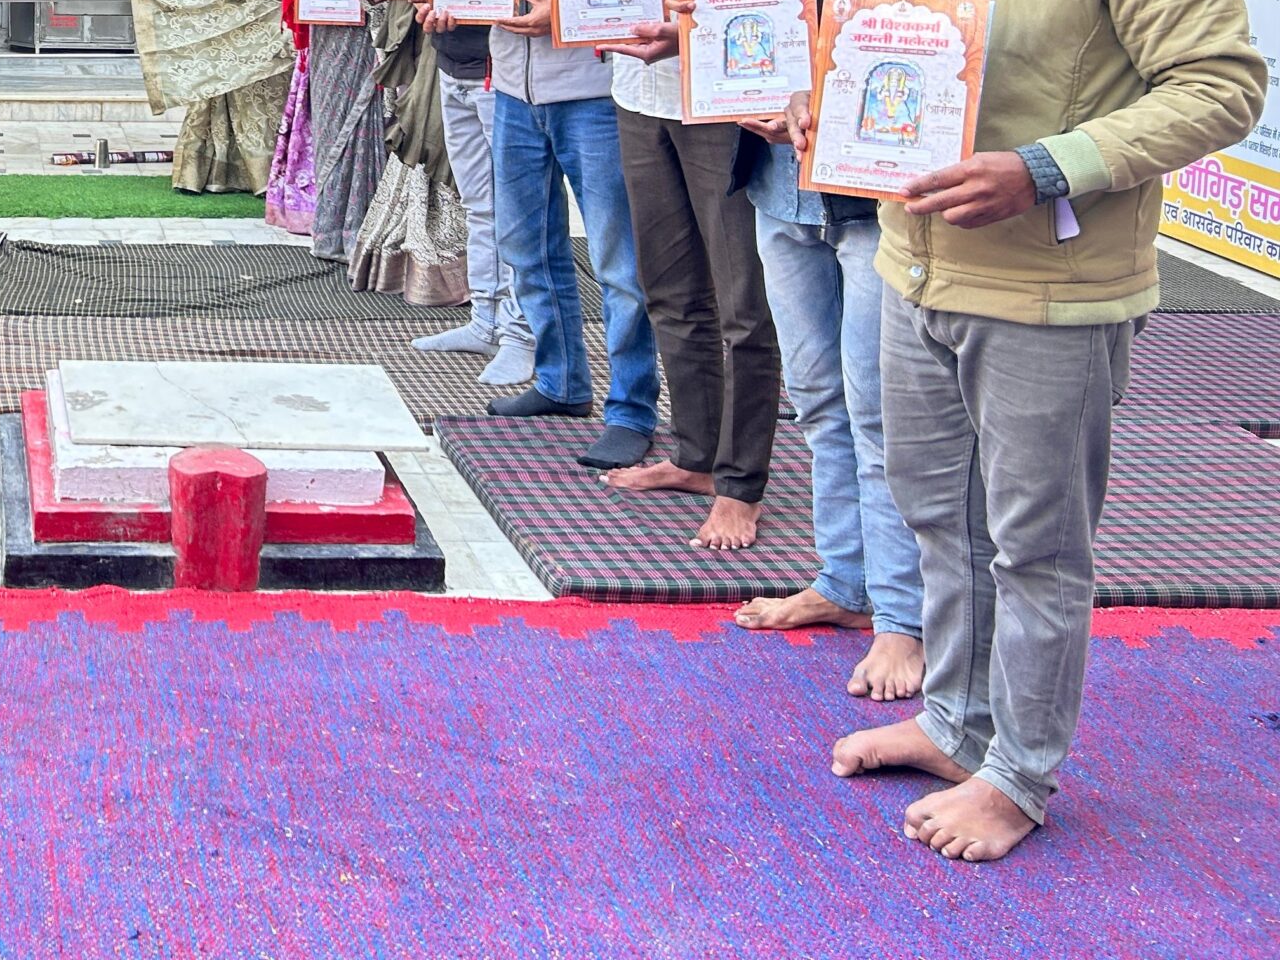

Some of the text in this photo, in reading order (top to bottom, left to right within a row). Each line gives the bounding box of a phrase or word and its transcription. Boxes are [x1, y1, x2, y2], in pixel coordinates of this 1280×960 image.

[860, 18, 941, 34] श्री विश्वकर्मा
[897, 34, 949, 49] महोत्सव
[1164, 201, 1180, 222] एवं
[1225, 221, 1265, 253] परिवार
